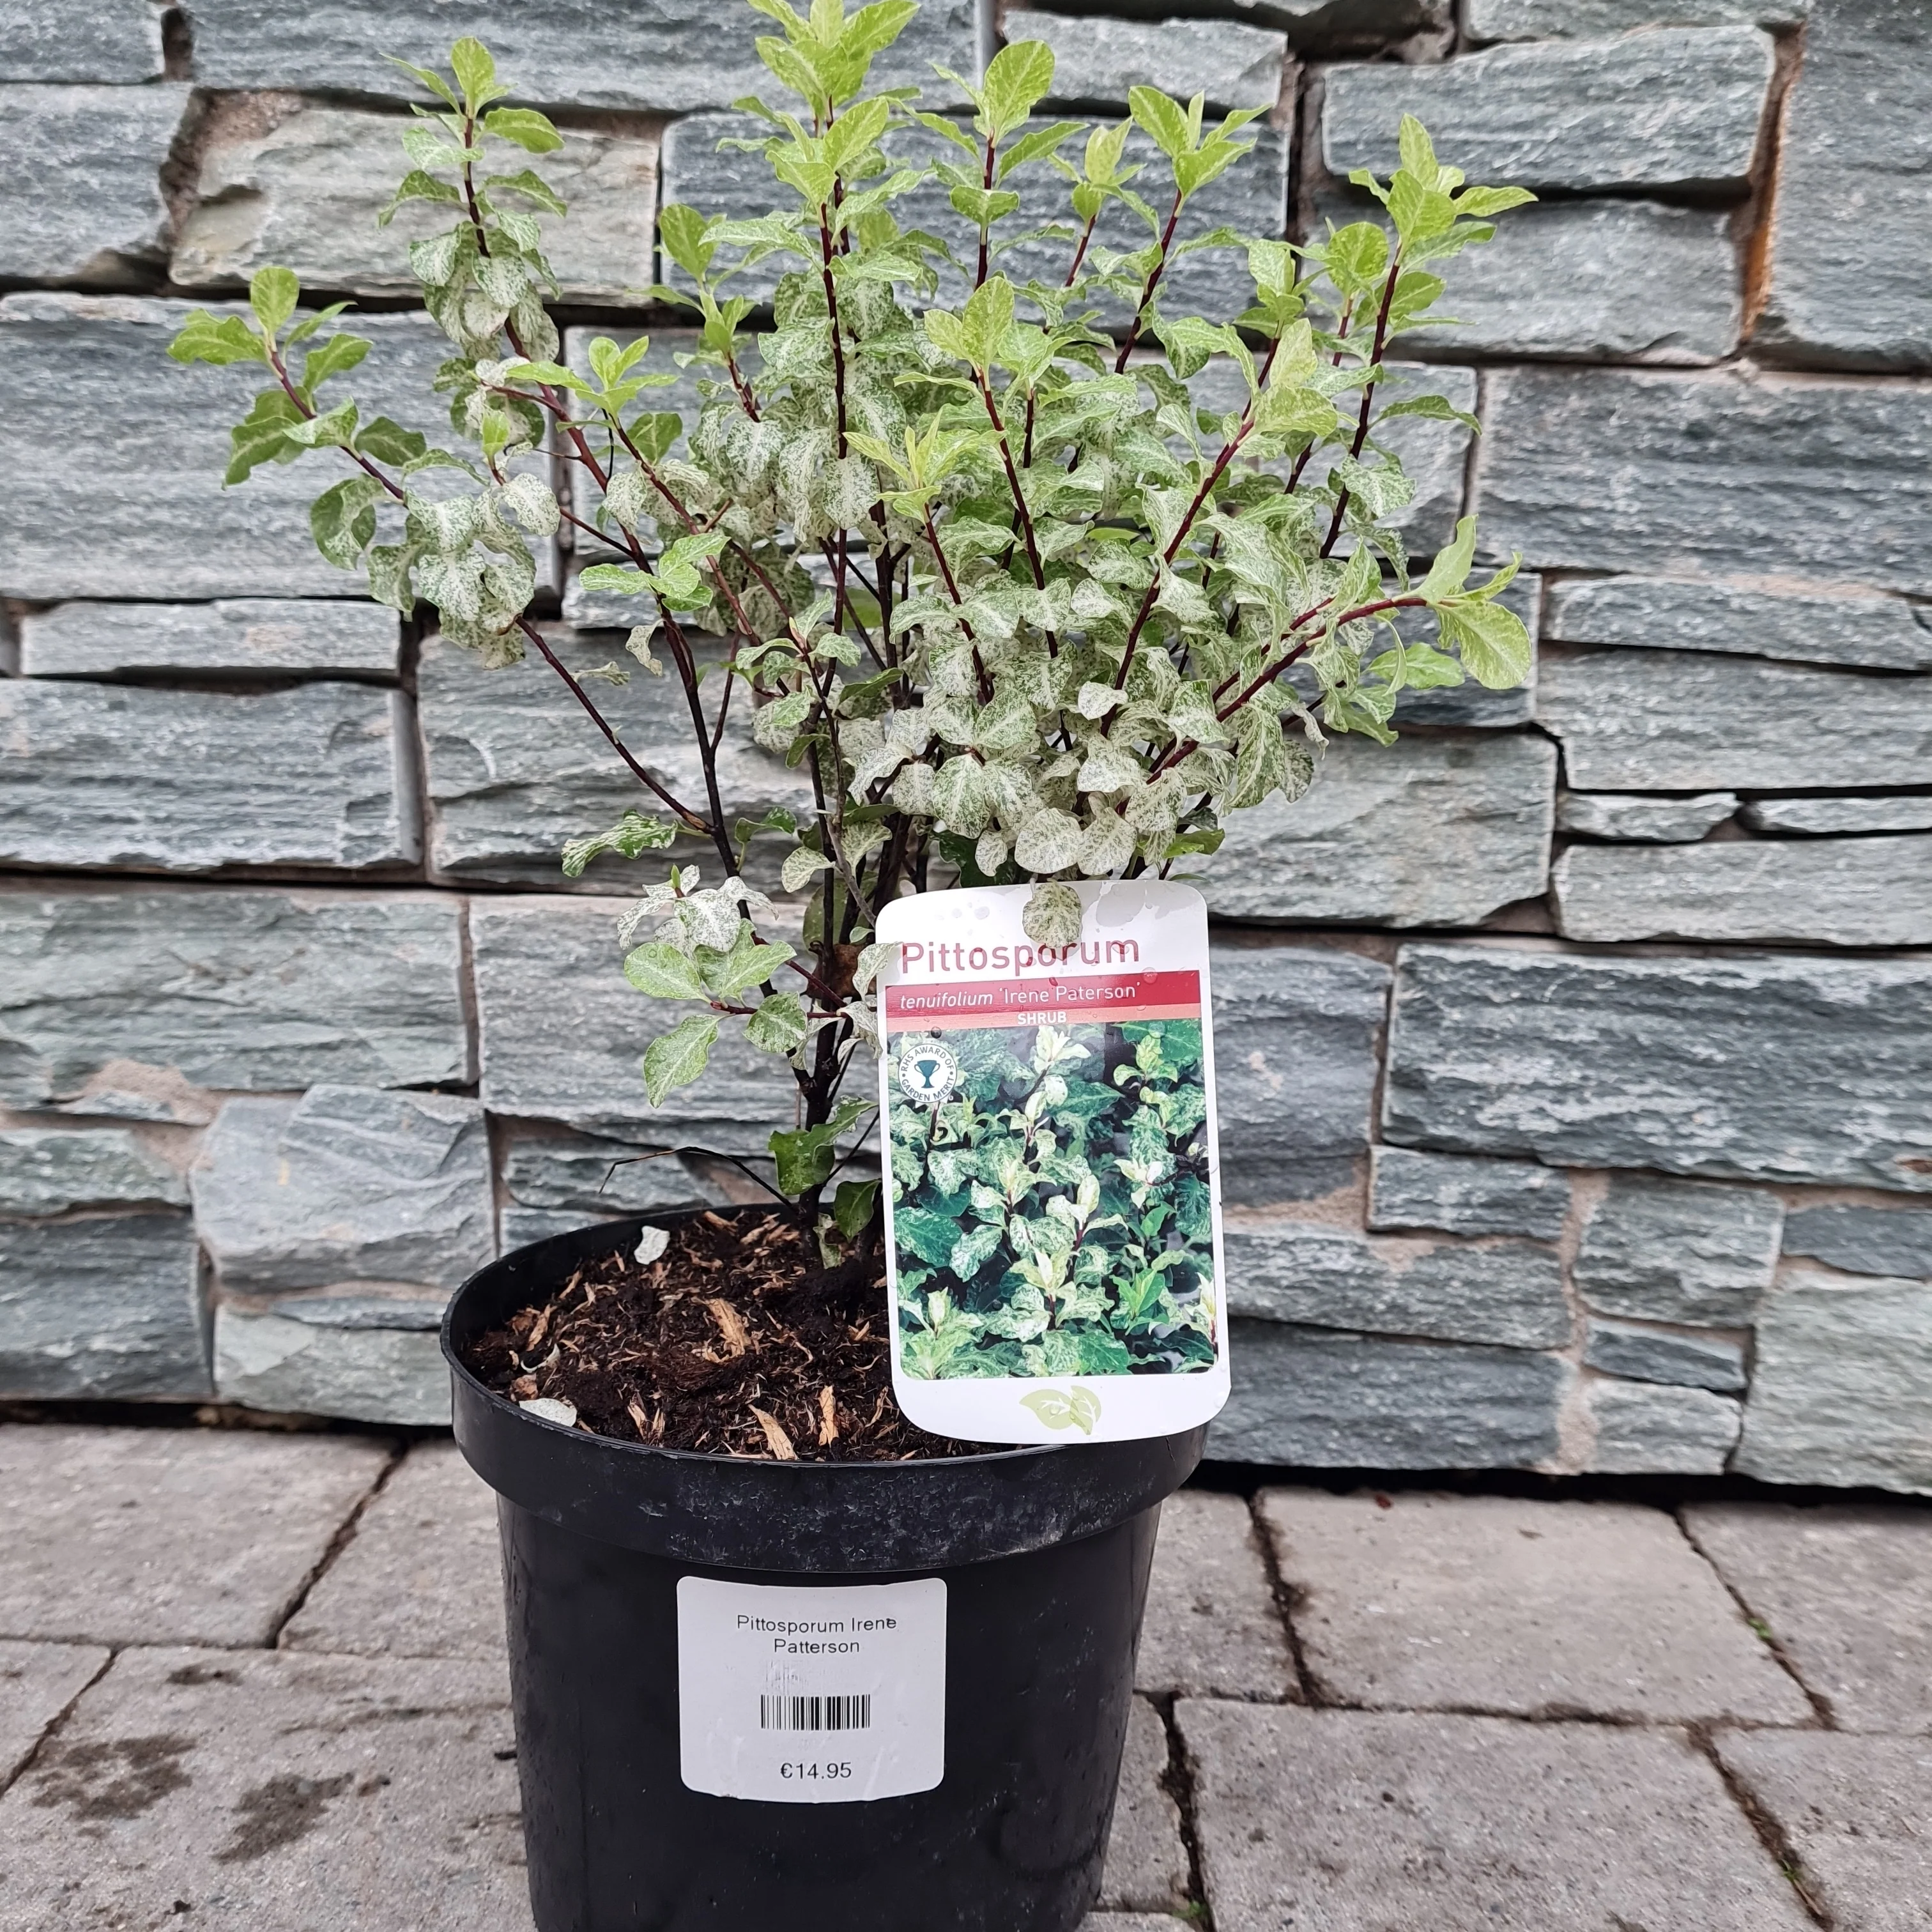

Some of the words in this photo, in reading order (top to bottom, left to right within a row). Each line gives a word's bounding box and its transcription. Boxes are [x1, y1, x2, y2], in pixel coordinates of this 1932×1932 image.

[902, 940, 1139, 976] Pittosporum
[900, 992, 993, 1009] tenuifolium
[1018, 1012, 1067, 1025] SHRUB
[901, 1054, 914, 1071] RHS
[915, 1046, 946, 1058] AWARD
[945, 1059, 954, 1070] OF
[902, 1078, 930, 1101] GARDEN
[933, 1076, 954, 1099] MERIT
[737, 1614, 844, 1636] Pittosporum
[852, 1618, 897, 1632] Irene
[774, 1638, 860, 1654] Patterson
[780, 1762, 852, 1779] €14.95
